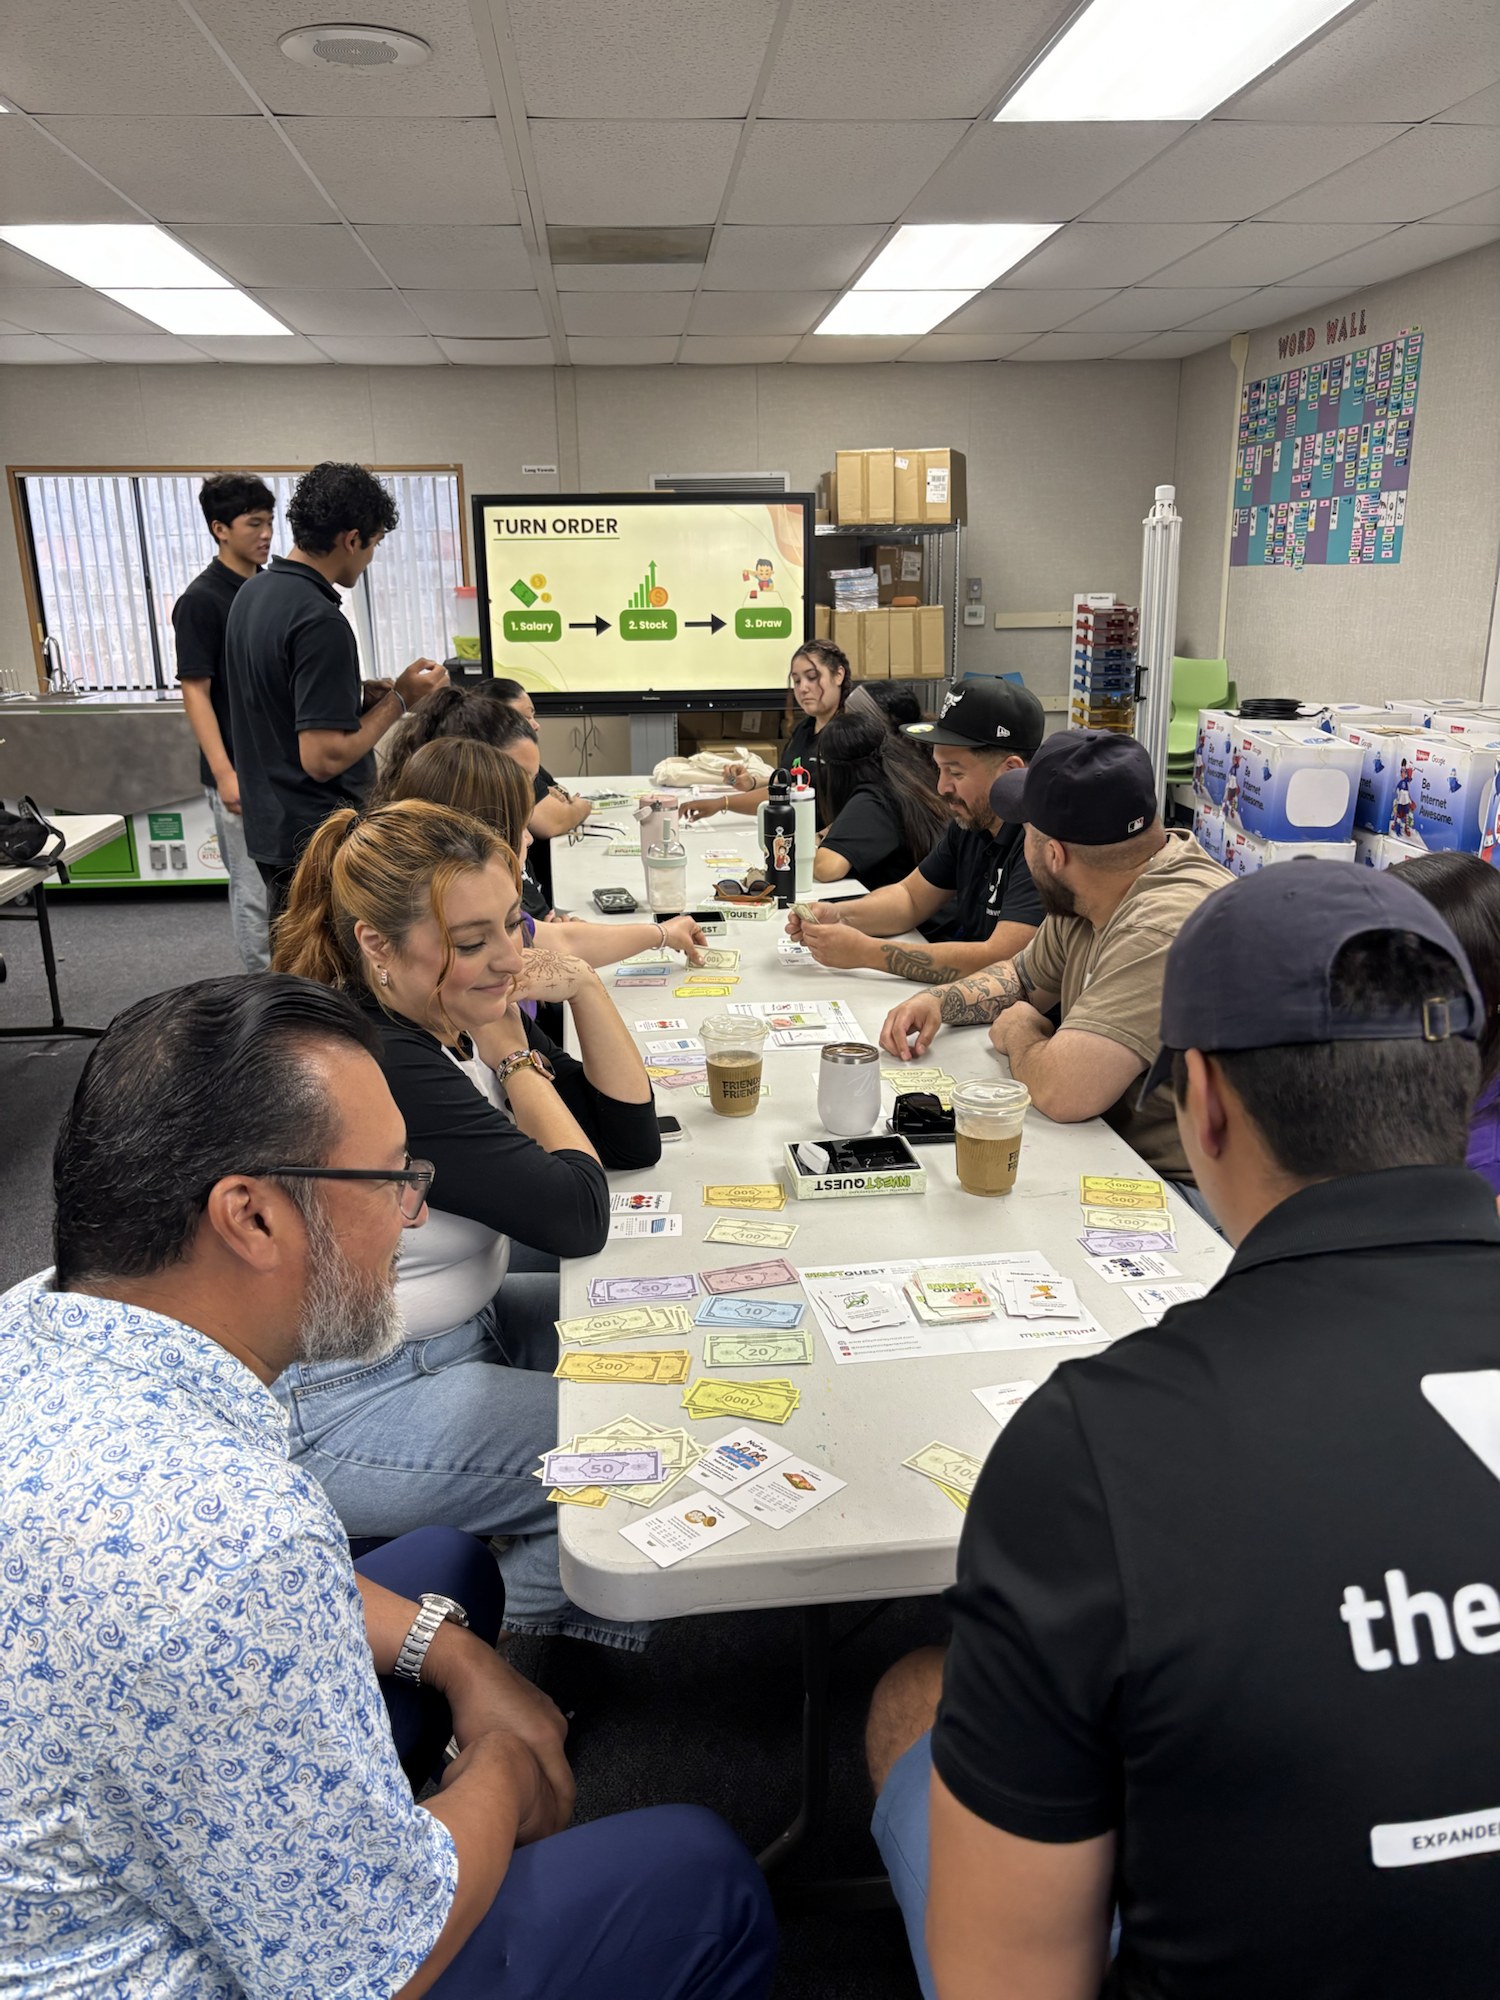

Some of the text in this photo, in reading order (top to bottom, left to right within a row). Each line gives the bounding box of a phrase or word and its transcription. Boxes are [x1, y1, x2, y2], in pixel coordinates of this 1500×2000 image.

[1278, 309, 1367, 360] WORD WALL
[493, 518, 618, 535] TURN ORDER
[510, 621, 554, 634] 1. Salary
[628, 619, 668, 630] 2. Stock
[744, 618, 782, 628] 3. Draw
[1432, 754, 1446, 766] Google
[1244, 766, 1251, 778] Be
[1242, 780, 1261, 796] Internet
[1422, 778, 1430, 790] Be
[1420, 791, 1447, 810] Internet
[1419, 806, 1454, 826] Awesome.
[1118, 1219, 1140, 1227] 100
[739, 1232, 761, 1240] 100
[641, 1284, 660, 1292] 50
[744, 1306, 763, 1316] 10
[594, 1320, 619, 1329] 100
[748, 1348, 768, 1356] 20
[594, 1362, 624, 1371] 500
[724, 1394, 756, 1406] 1000
[747, 1440, 768, 1452] Nurse
[590, 1464, 614, 1474] 50
[1340, 1568, 1500, 1672] the
[1412, 1822, 1500, 1850] EXPANDE
